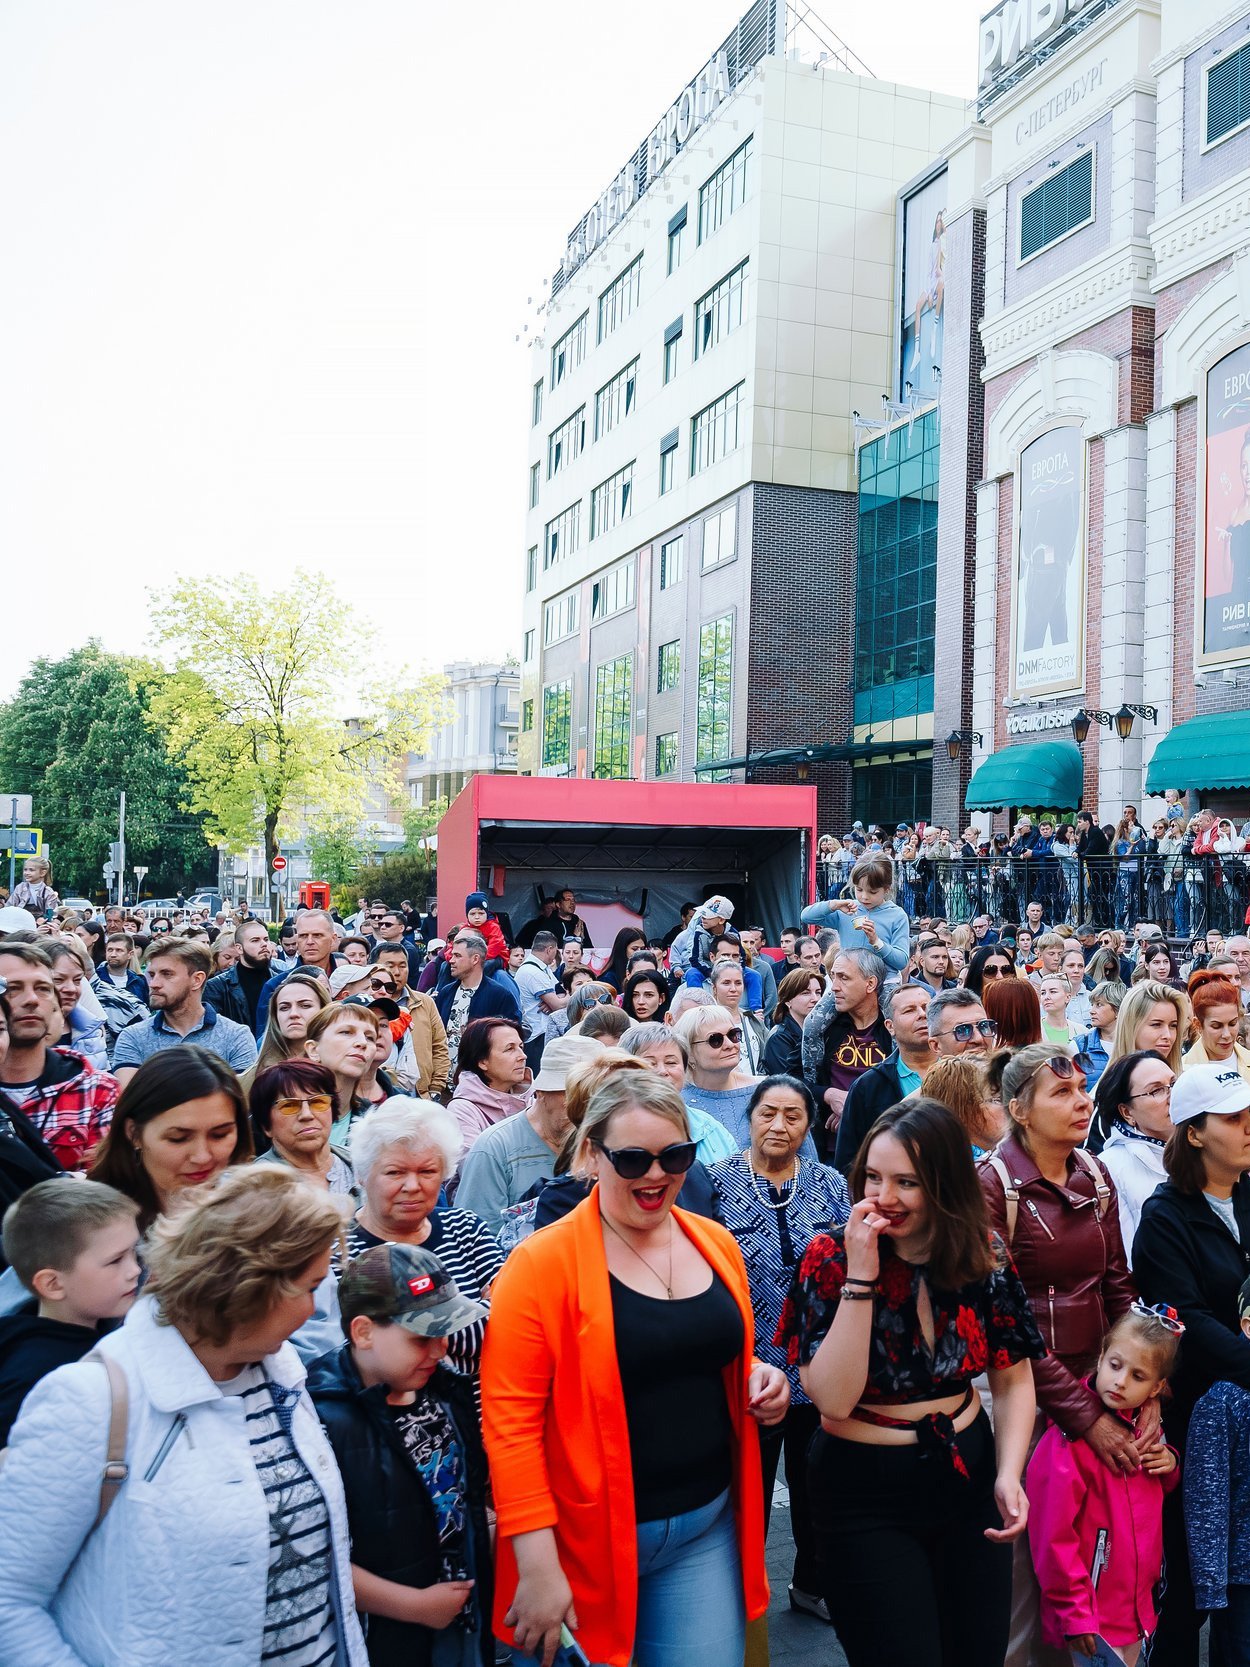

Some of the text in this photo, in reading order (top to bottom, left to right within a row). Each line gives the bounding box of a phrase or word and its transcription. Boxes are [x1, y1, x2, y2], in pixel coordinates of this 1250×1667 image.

[1015, 57, 1108, 146] С-ПЕТЕРБУРГ
[1031, 451, 1069, 480] ЕВРОПА
[1222, 603, 1245, 623] РИВ
[837, 1045, 886, 1067] ONLY
